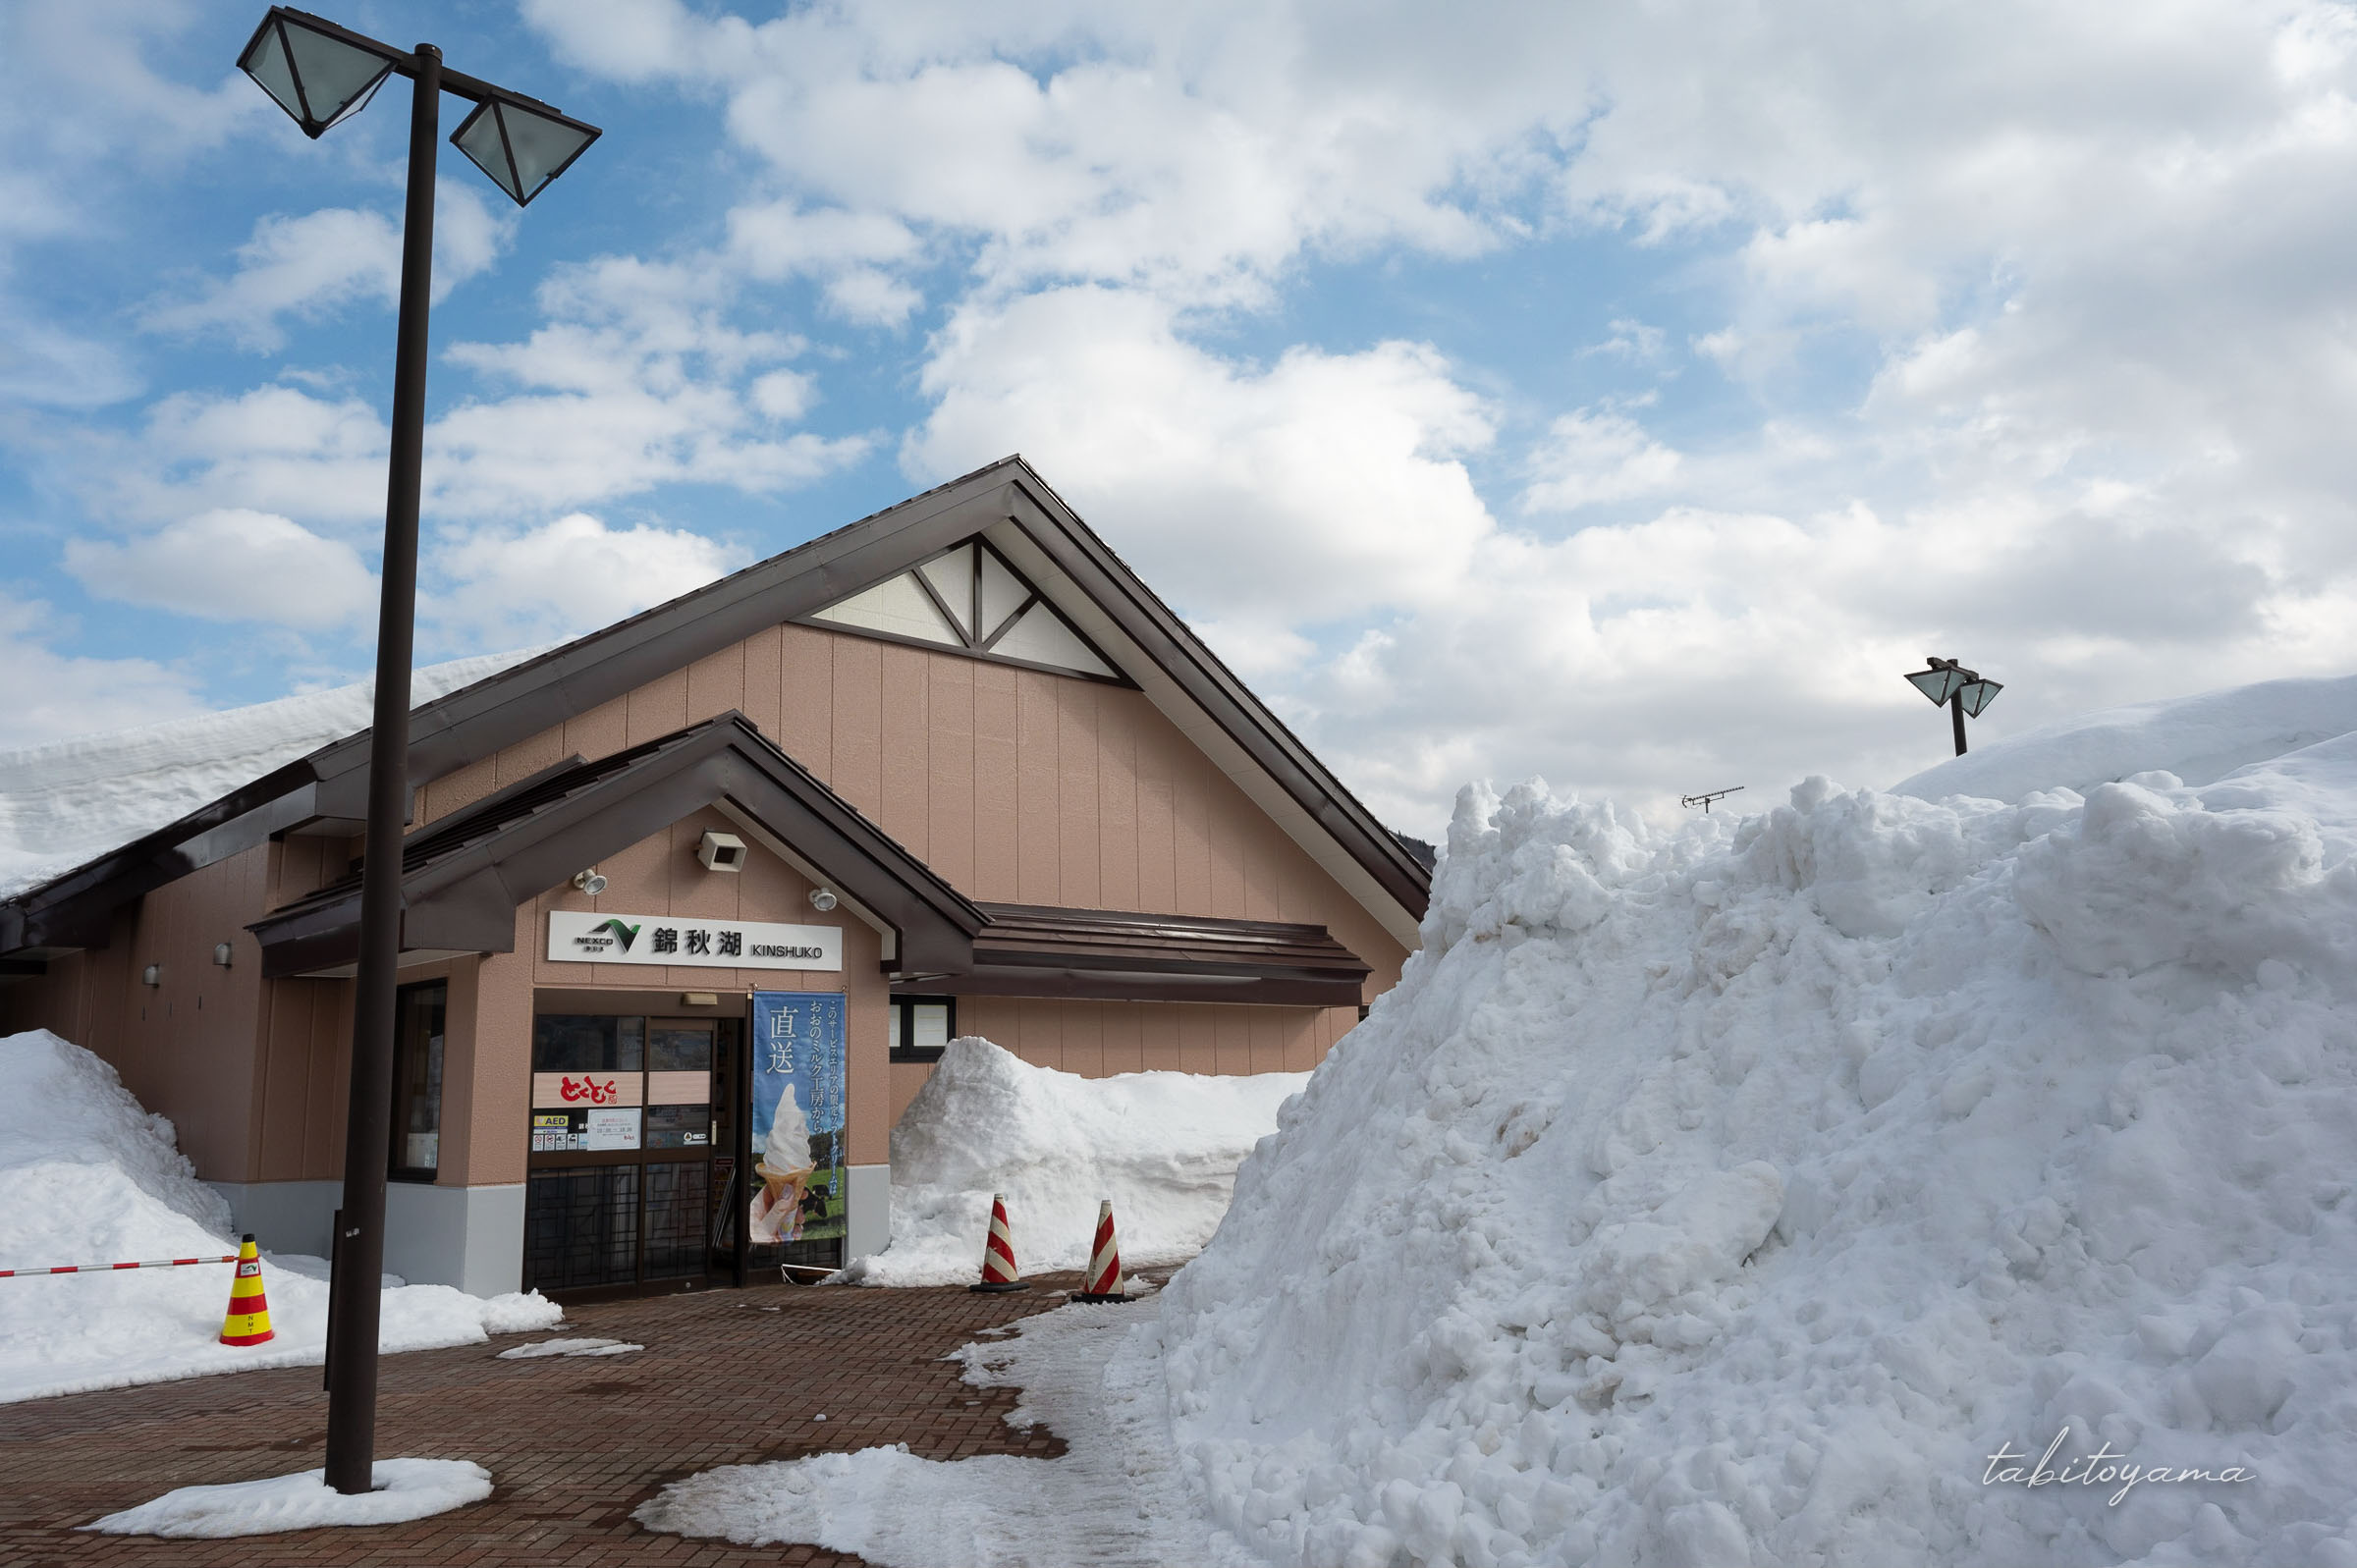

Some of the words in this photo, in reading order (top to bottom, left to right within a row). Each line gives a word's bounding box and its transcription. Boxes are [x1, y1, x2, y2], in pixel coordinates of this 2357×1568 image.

[575, 937, 614, 946] NEXCO
[652, 927, 741, 956] 錦秋湖
[751, 944, 823, 959] KINSHUKO
[766, 1005, 799, 1074] 直送
[809, 1000, 825, 1133] おおのミルク工房から
